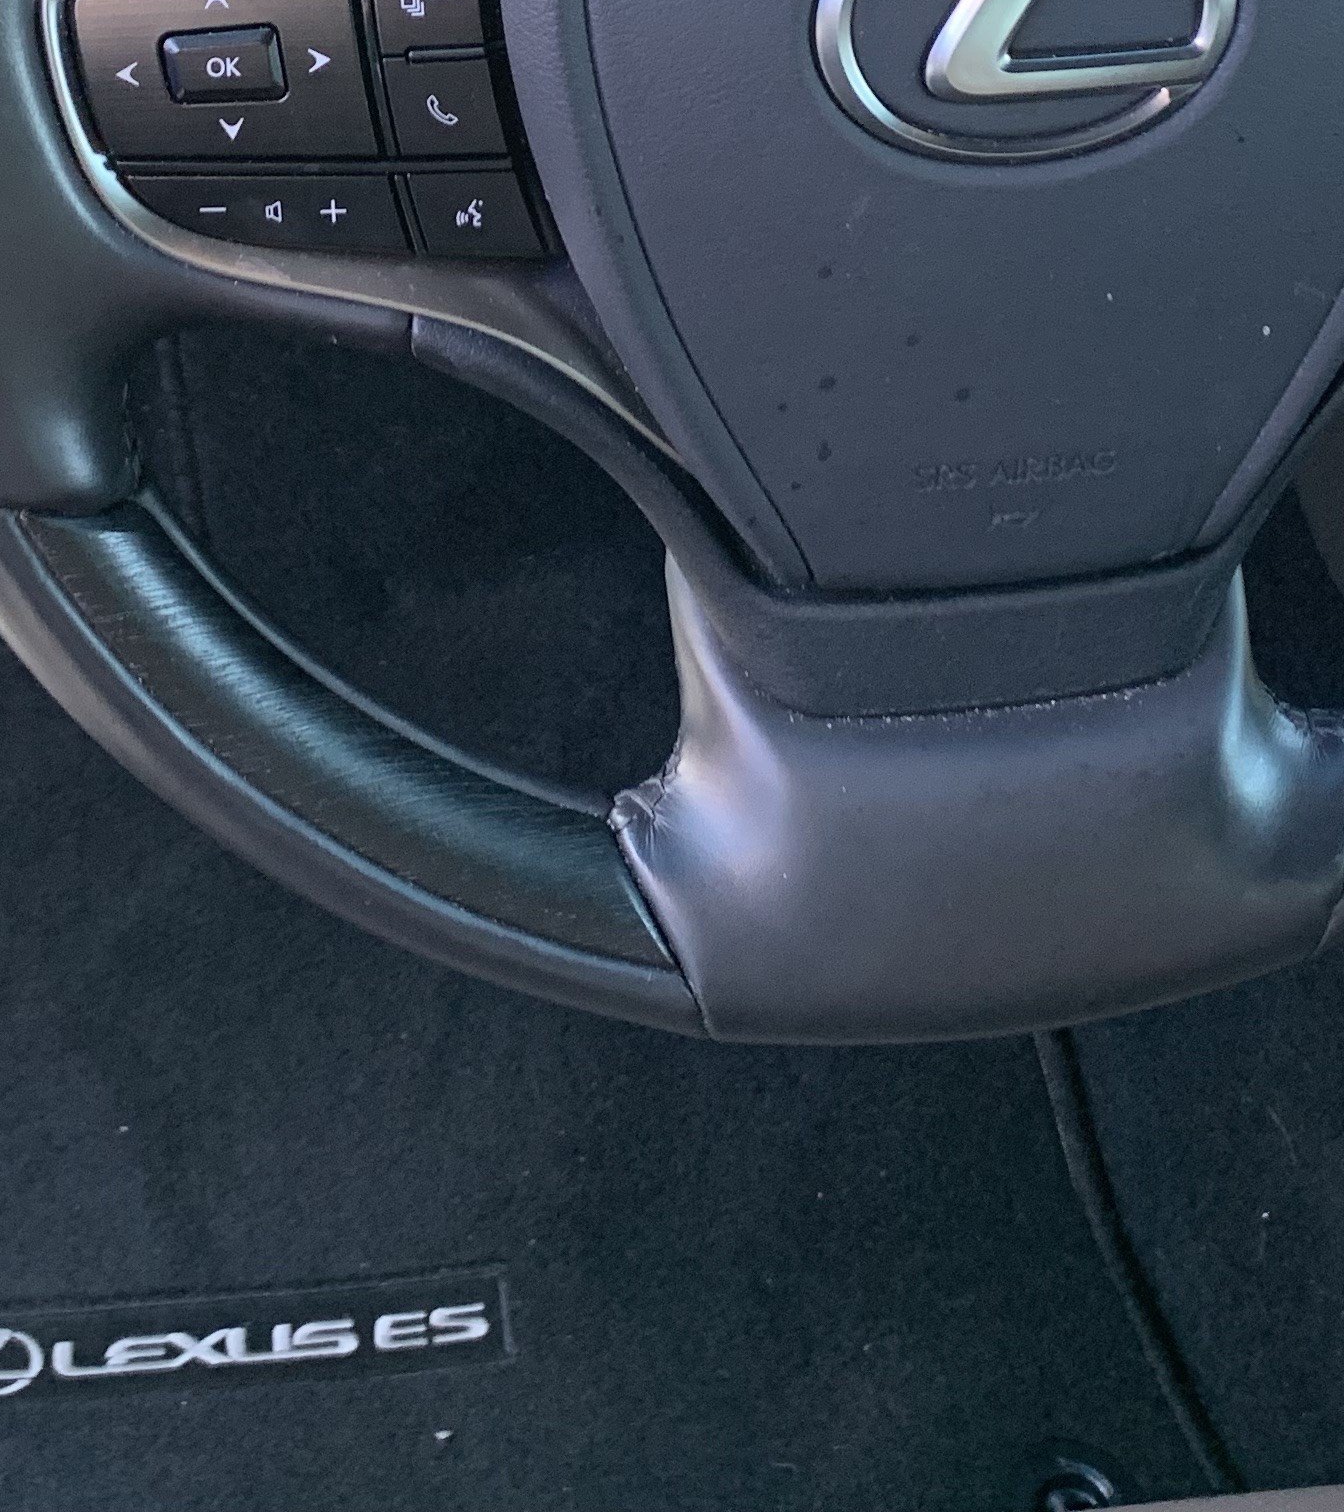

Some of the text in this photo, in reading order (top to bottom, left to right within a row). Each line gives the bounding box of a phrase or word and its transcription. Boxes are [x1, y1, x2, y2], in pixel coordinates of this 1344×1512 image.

[205, 56, 241, 78] OK
[53, 1319, 358, 1376] LEXUS
[373, 1302, 489, 1351] ES
